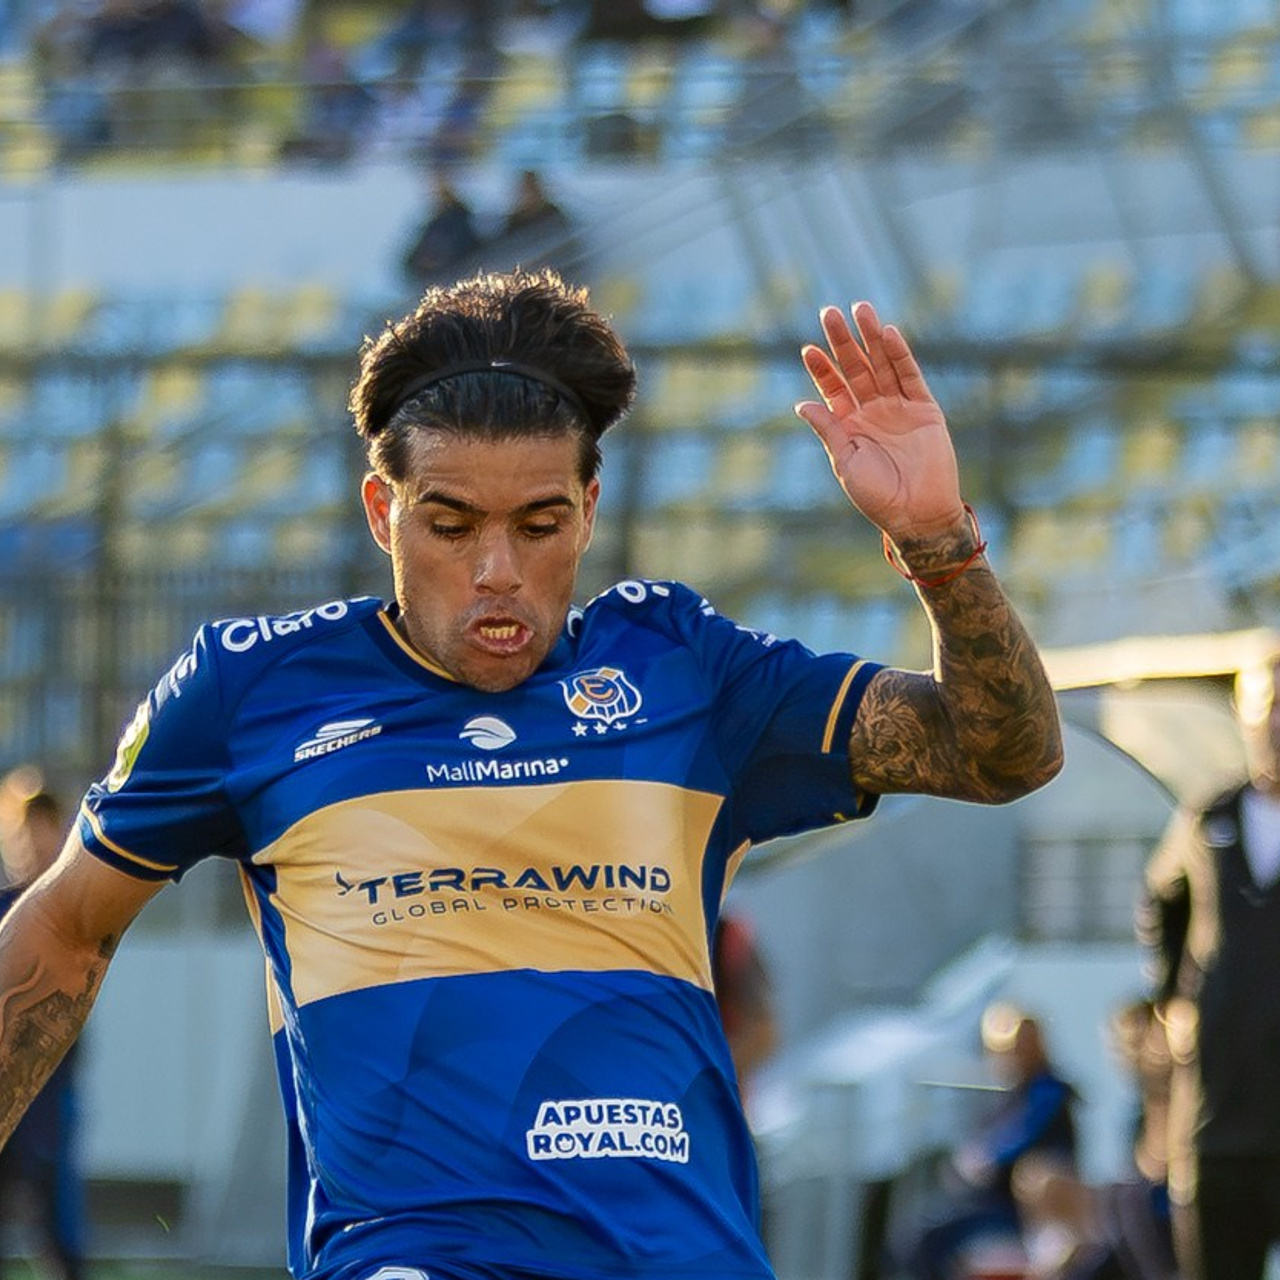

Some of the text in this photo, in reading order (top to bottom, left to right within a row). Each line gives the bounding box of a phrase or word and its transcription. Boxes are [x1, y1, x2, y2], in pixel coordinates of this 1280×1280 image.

[222, 599, 348, 652] Claro
[293, 724, 383, 763] SKECHERS
[356, 864, 672, 905] TERRAWIND
[372, 897, 486, 927] GLOBAL
[541, 1104, 681, 1130] APUESTAS
[532, 1131, 687, 1158] ROYAL.COM
